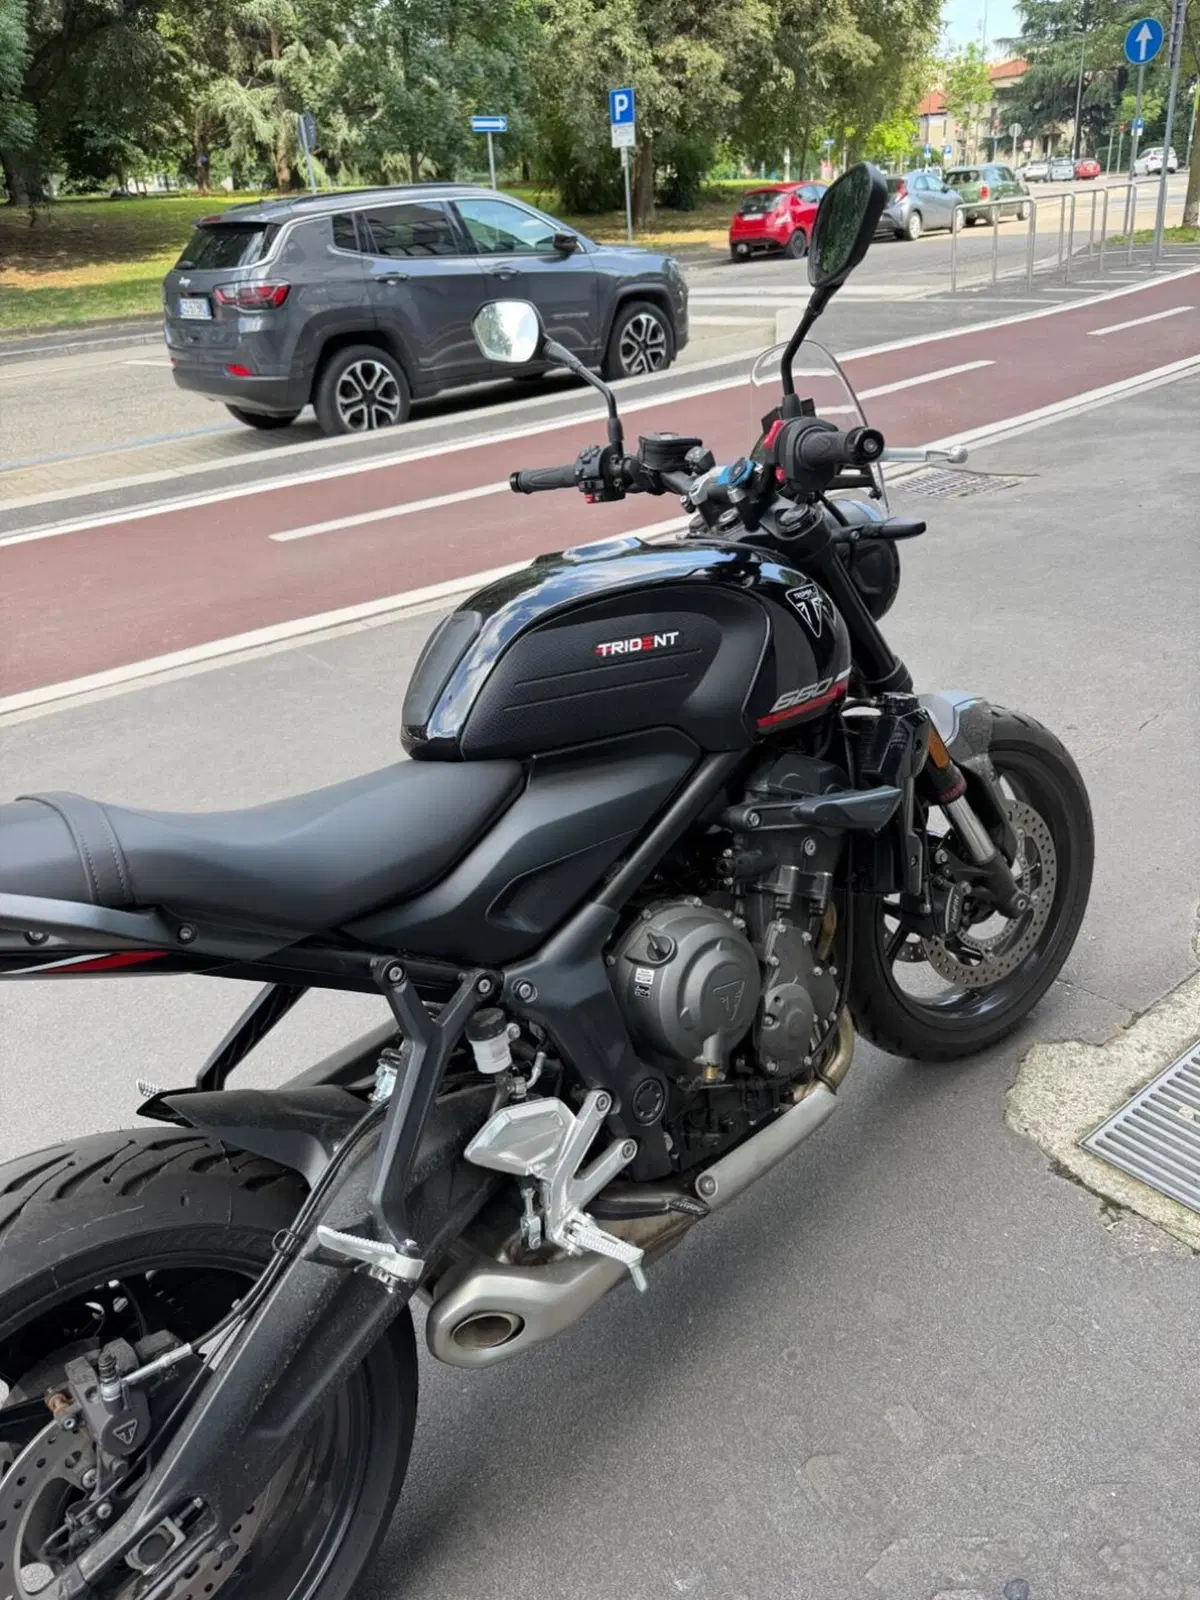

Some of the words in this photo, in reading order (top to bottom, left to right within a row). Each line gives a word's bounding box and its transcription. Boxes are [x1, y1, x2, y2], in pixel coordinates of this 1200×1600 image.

[614, 94, 628, 120] P
[595, 631, 679, 657] TRIDENT
[769, 677, 834, 714] 660
